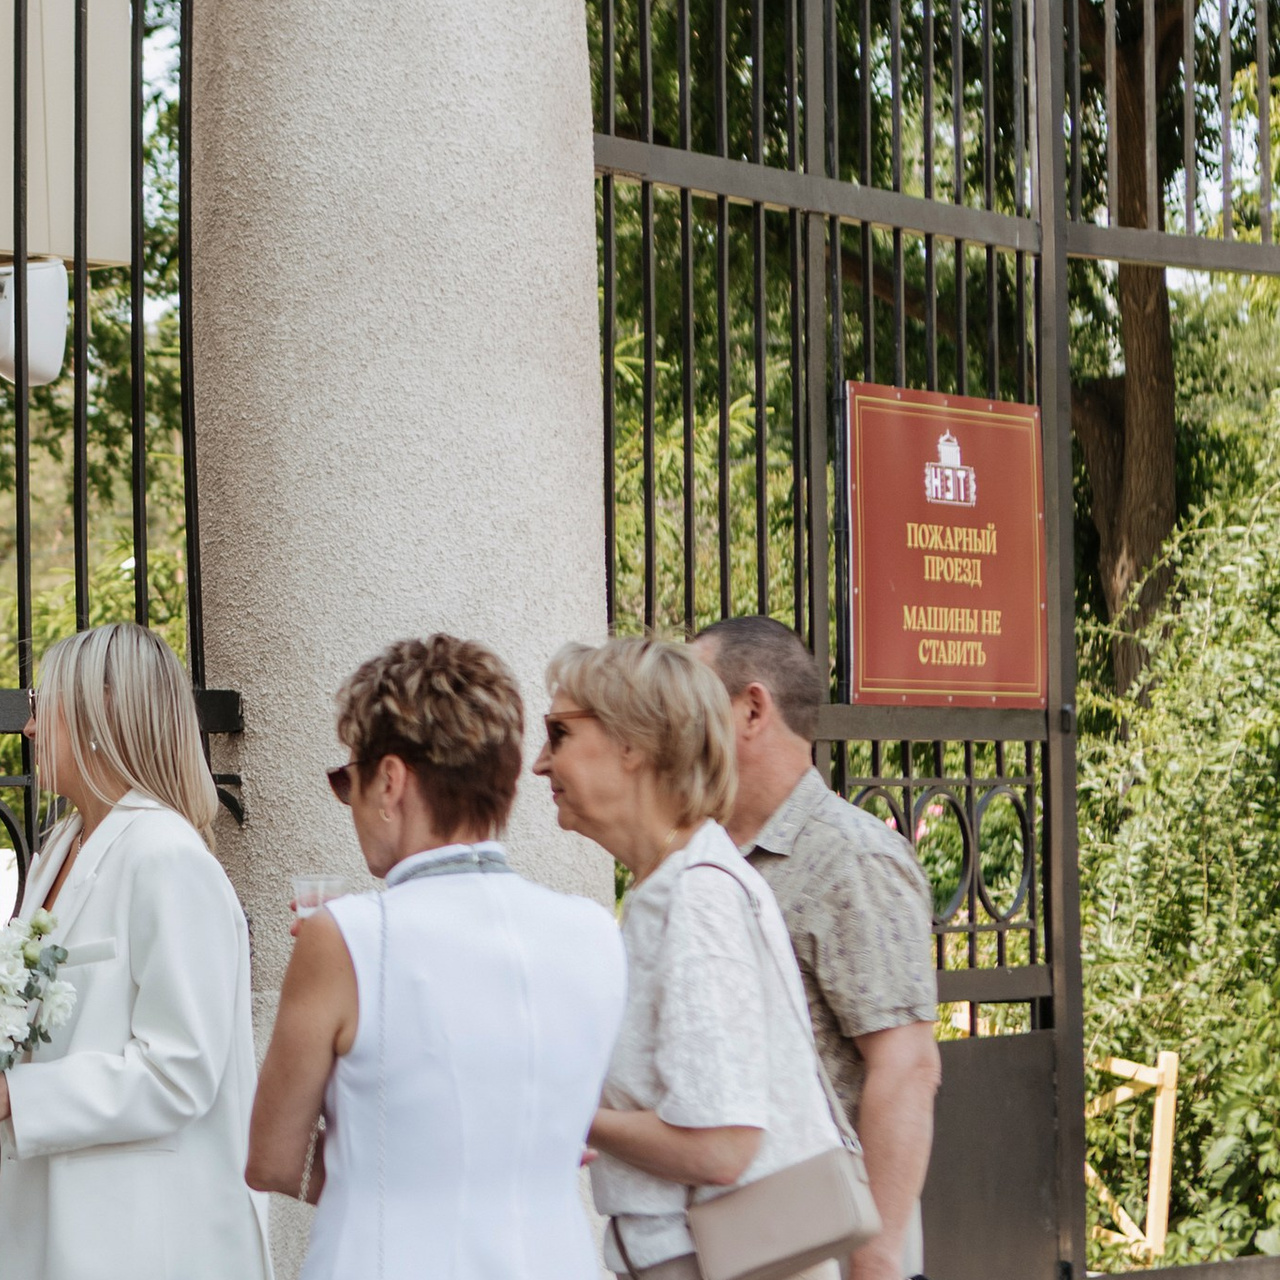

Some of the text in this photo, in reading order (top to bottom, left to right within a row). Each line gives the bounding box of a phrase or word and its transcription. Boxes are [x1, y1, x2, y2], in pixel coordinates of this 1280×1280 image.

[906, 522, 998, 555] ПОЖАРНЫЙ
[923, 555, 983, 588] ПРОЕЗД
[903, 605, 1002, 635] МАШИНЫ НЕ
[918, 638, 987, 667] СТАВИТЬ
